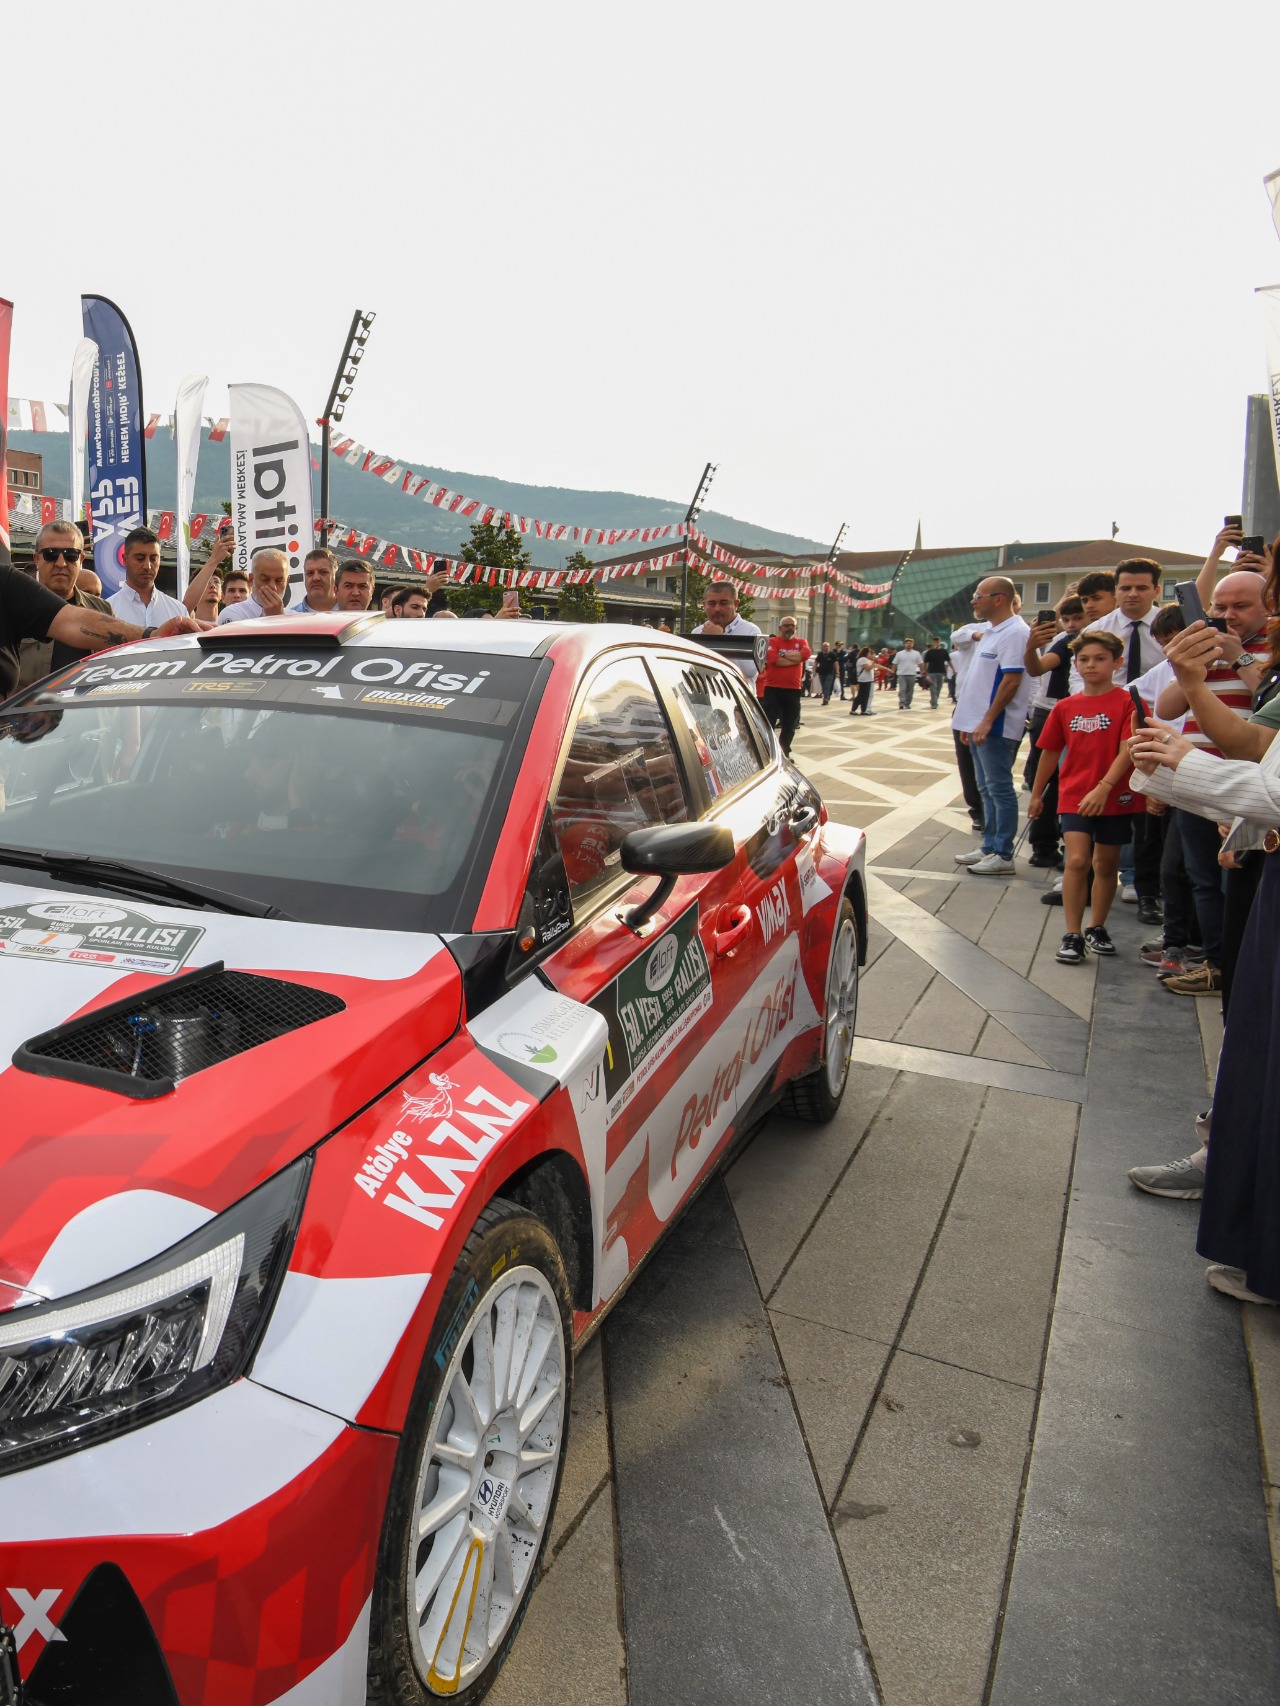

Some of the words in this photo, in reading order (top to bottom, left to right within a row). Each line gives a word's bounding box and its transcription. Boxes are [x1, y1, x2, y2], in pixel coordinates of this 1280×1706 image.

[70, 660, 187, 685] Team
[191, 652, 345, 677] Petrol
[351, 658, 491, 694] Ofisi
[189, 682, 234, 692] TRS
[366, 690, 456, 706] maxima
[43, 905, 110, 918] aloft
[38, 933, 59, 945] 1
[71, 951, 97, 960] TRS
[671, 1018, 752, 1182] Petrol
[750, 958, 799, 1065] Ofisi
[354, 1130, 413, 1199] Atölye
[383, 1085, 531, 1231] KAZAZ
[488, 1481, 506, 1517] HYUNDAI
[495, 1486, 511, 1520] MOTORSPORT
